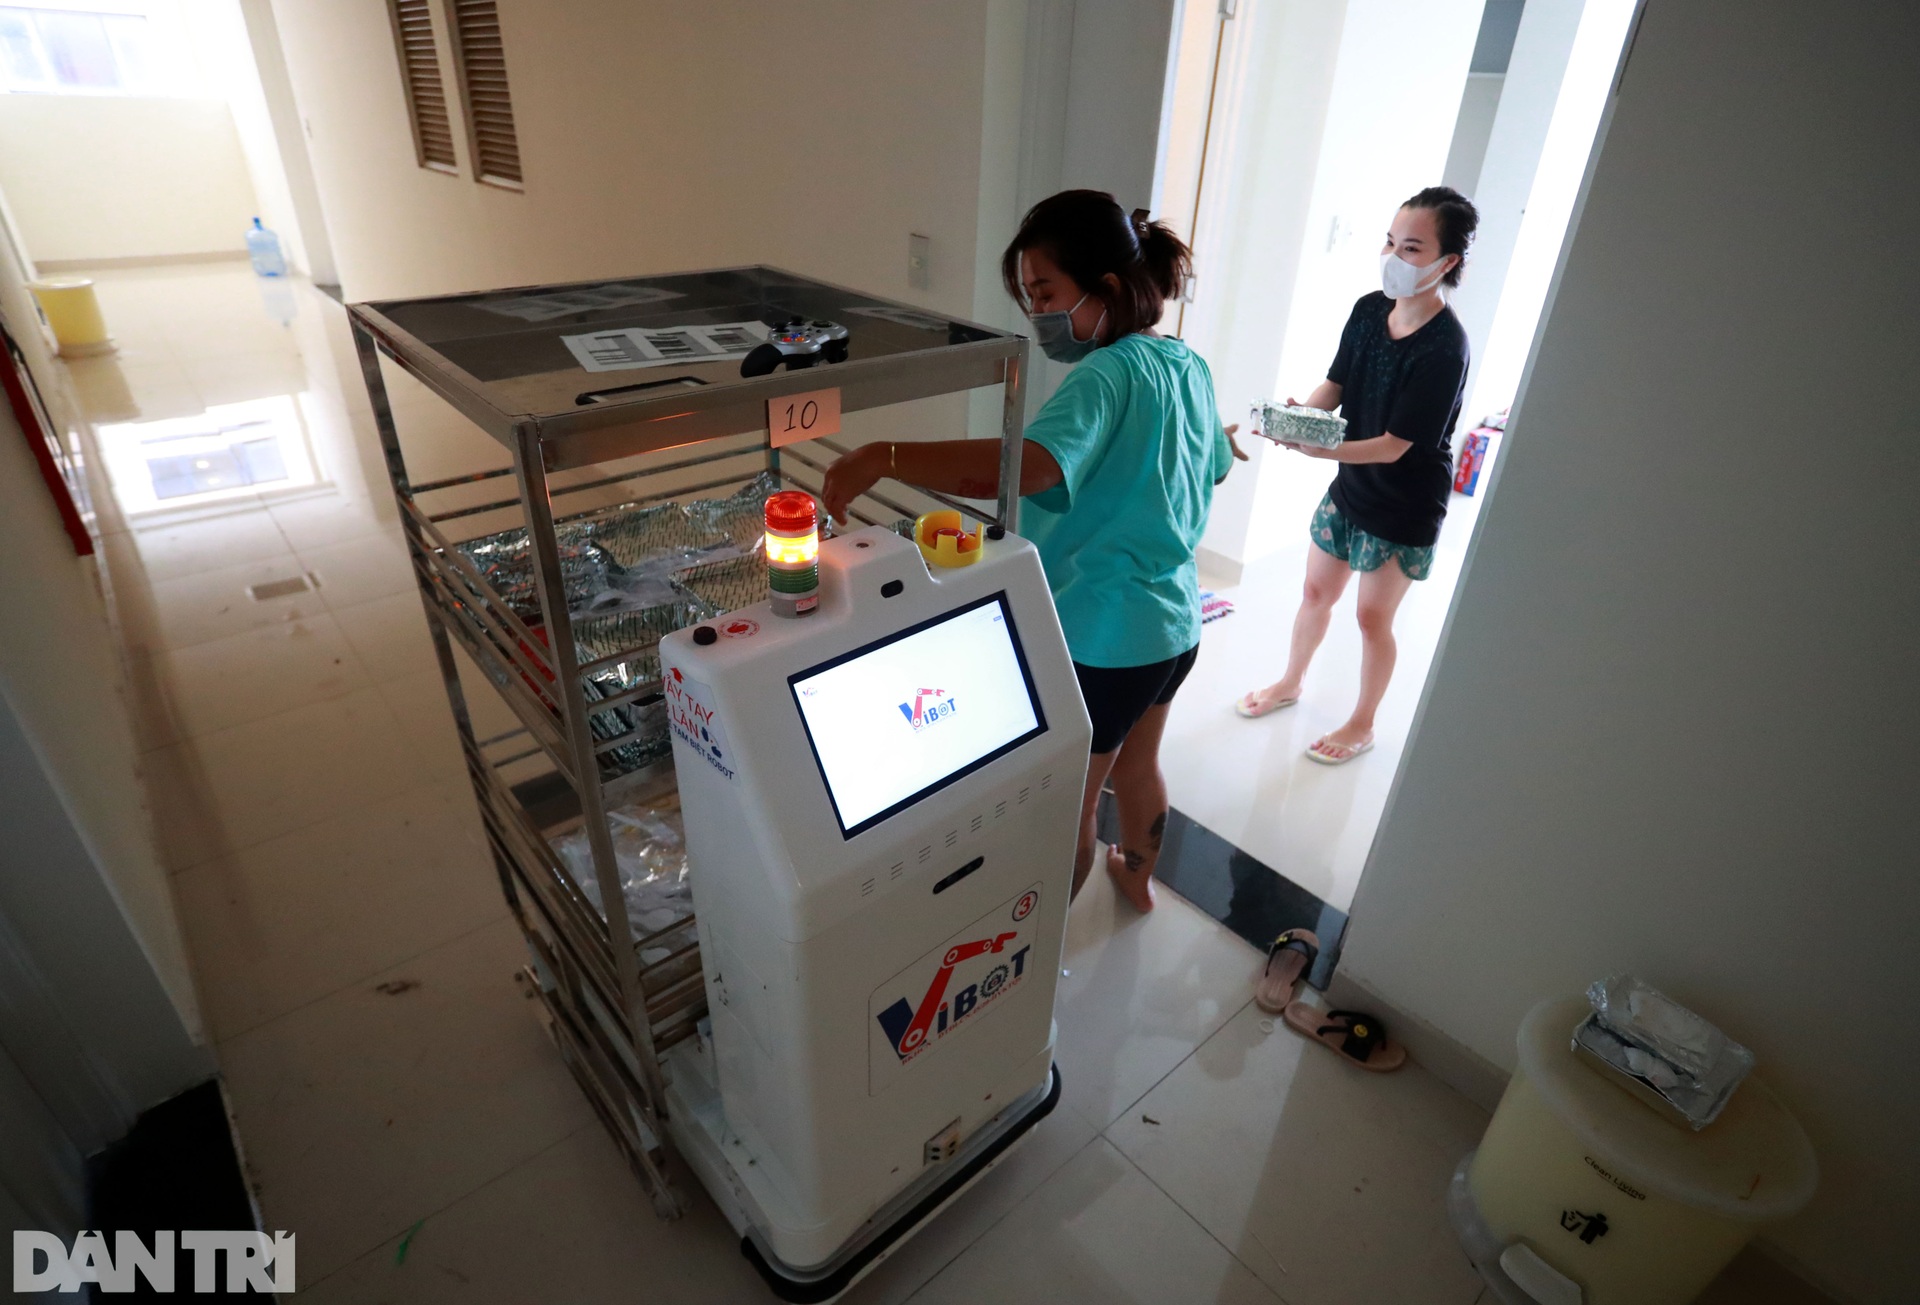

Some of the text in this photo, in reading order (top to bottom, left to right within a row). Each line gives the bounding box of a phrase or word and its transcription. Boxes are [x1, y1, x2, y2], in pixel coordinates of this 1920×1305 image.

[783, 400, 818, 432] 10
[685, 693, 714, 726] TAY
[706, 753, 734, 780] ROBOT
[1018, 896, 1031, 916] 3
[1584, 1156, 1612, 1179] Clean
[1613, 1177, 1646, 1201] Living
